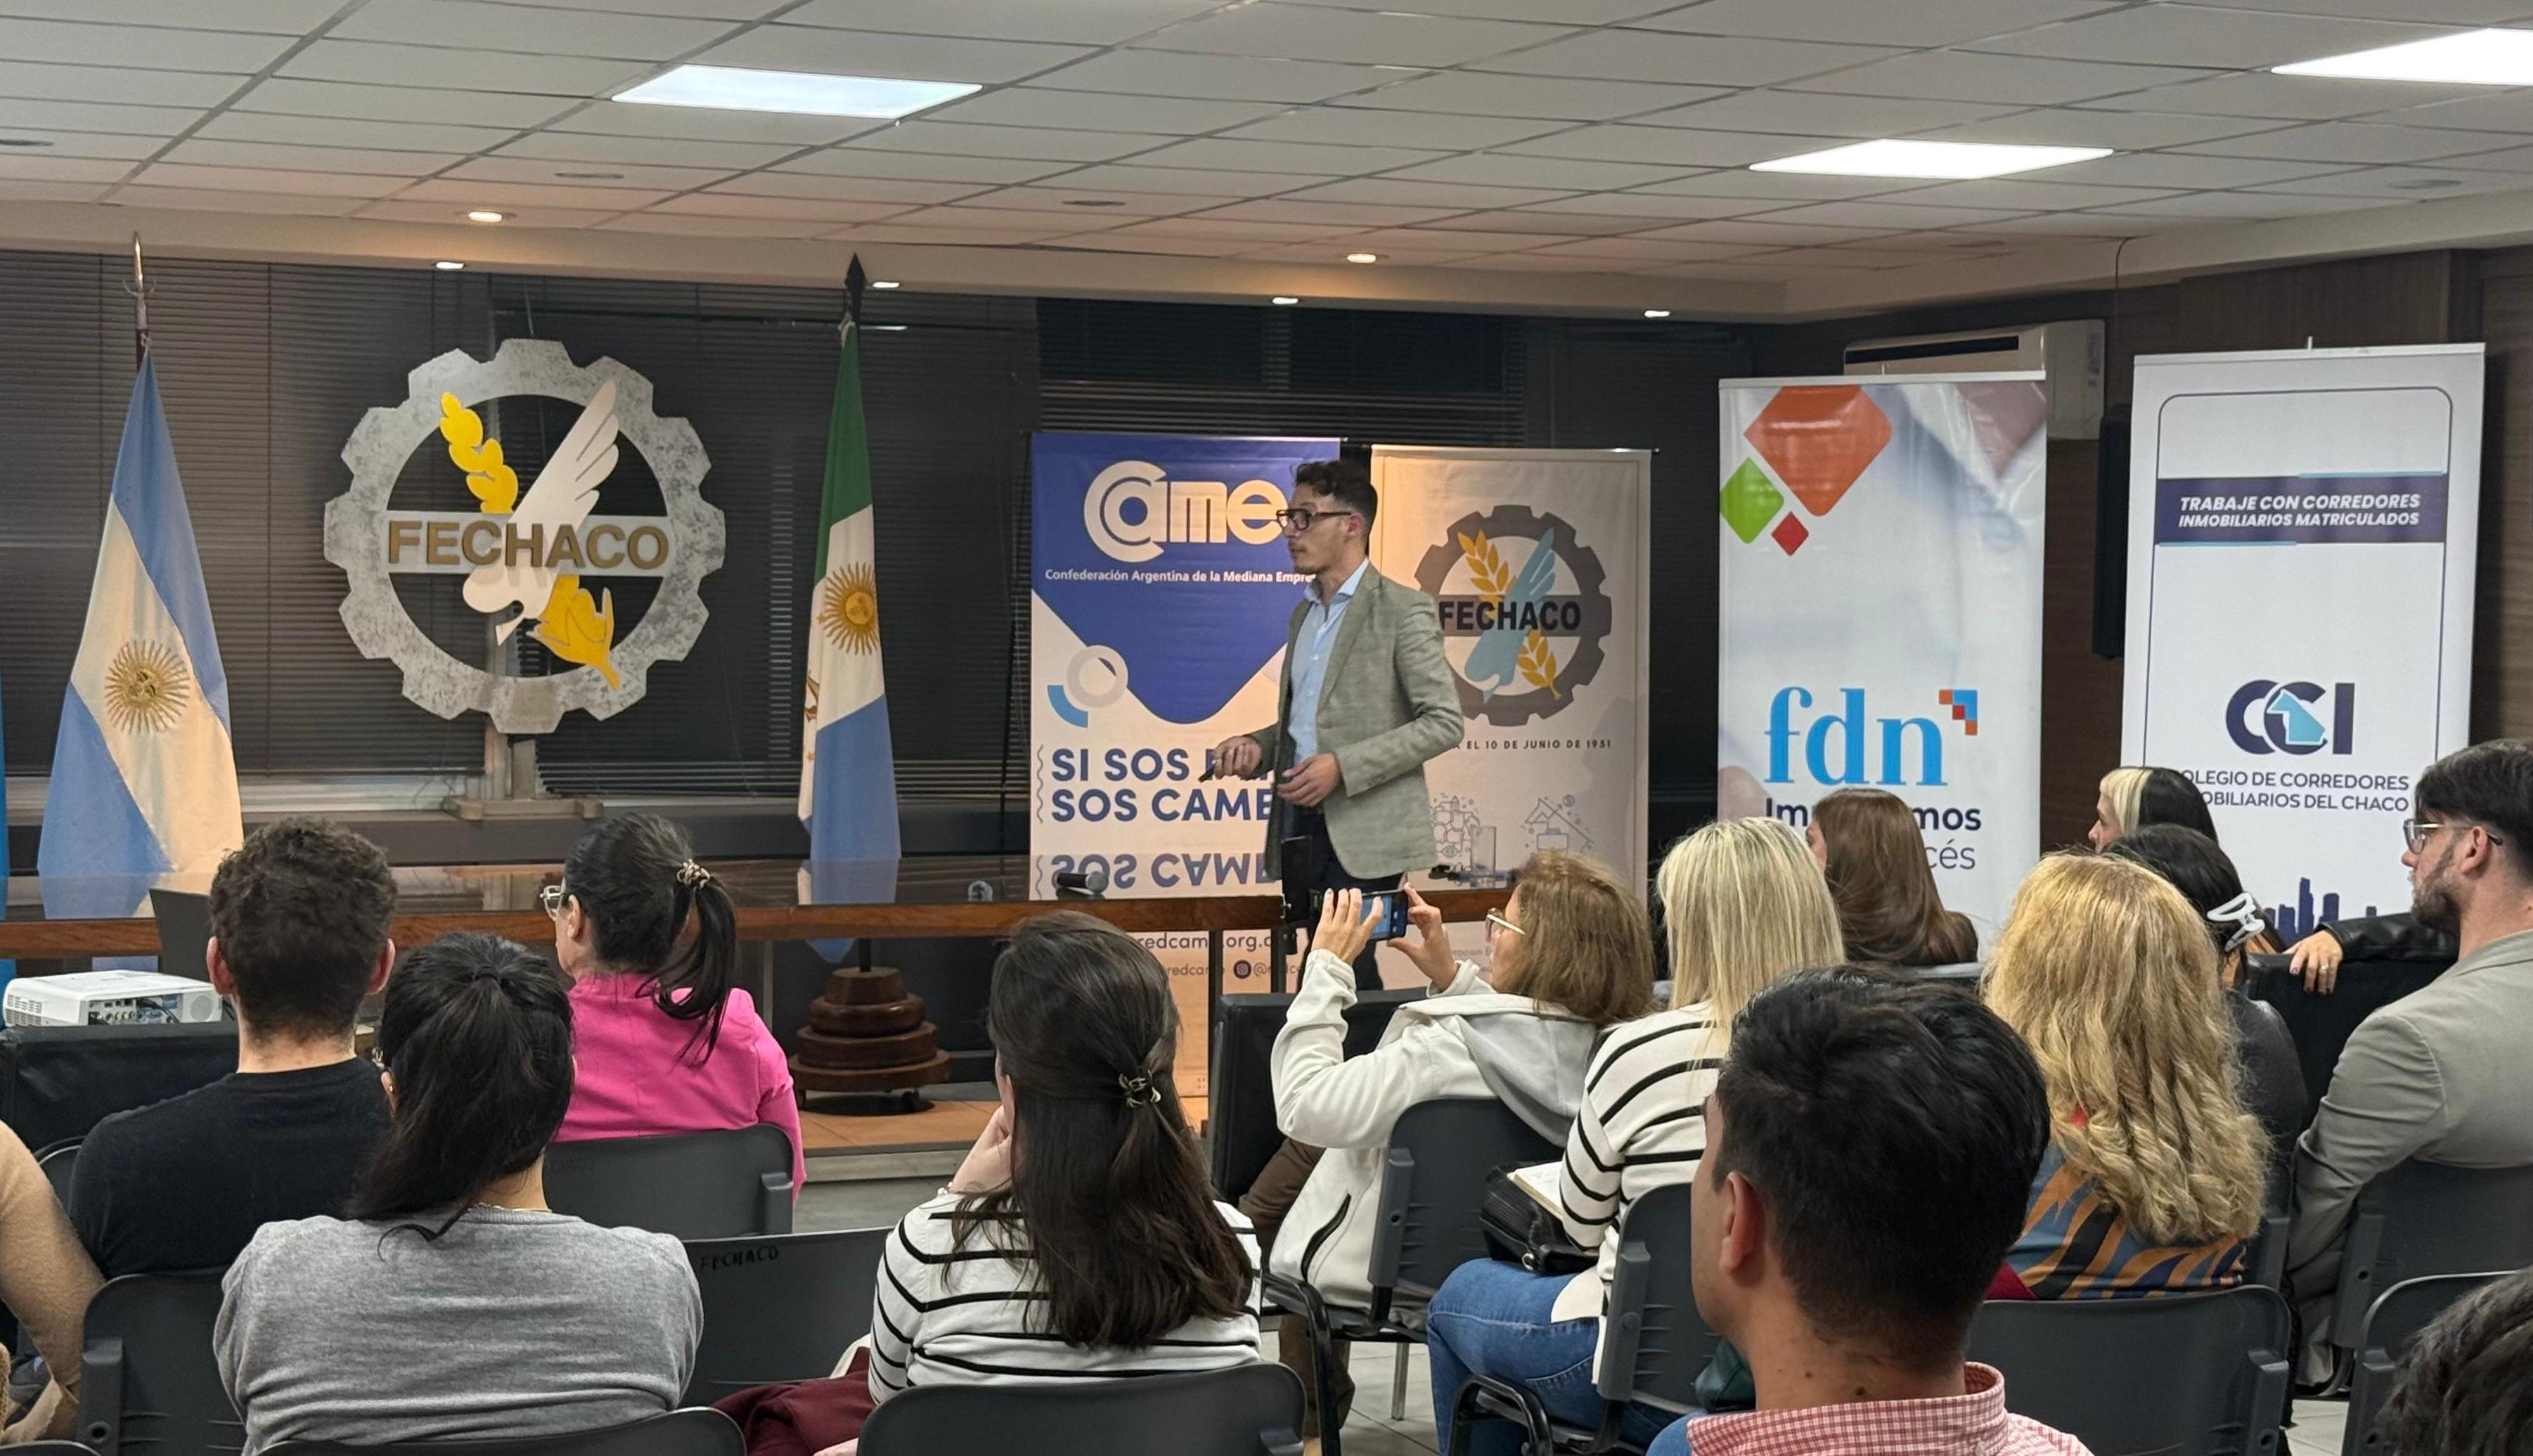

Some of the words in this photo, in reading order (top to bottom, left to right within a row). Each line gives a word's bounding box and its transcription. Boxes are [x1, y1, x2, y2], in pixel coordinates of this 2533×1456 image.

[2179, 496, 2258, 512] TRABAJE
[2260, 495, 2300, 511] CON
[2302, 494, 2421, 510] CORREDORES
[2178, 513, 2293, 528] INMOBILIARIOS
[2295, 512, 2420, 527] MATRICULADOS
[388, 520, 669, 569] FECHACO
[1045, 569, 1128, 581] Confederación
[1131, 569, 1189, 584] Argentina
[1192, 570, 1207, 582] de
[1210, 570, 1220, 582] la
[1223, 570, 1273, 583] Mediana
[1438, 600, 1581, 631] FECHACO
[1467, 740, 1480, 749] EL
[1485, 740, 1498, 749] 10
[1504, 740, 1519, 749] DE
[1523, 740, 1561, 749] JUNIO
[1566, 740, 1581, 749] DE
[1586, 739, 1611, 749] 1951
[1763, 686, 1948, 787] fdn
[1052, 748, 1088, 781] SI
[1104, 748, 1190, 781] SOS
[2181, 770, 2248, 786] OLEGIO
[2252, 772, 2276, 787] DE
[2280, 772, 2409, 791] CORREDORES
[1051, 788, 1138, 822] SOS
[2201, 791, 2301, 808] OBILIARIOS
[2303, 794, 2338, 809] DEL
[2341, 795, 2409, 812] CHACO
